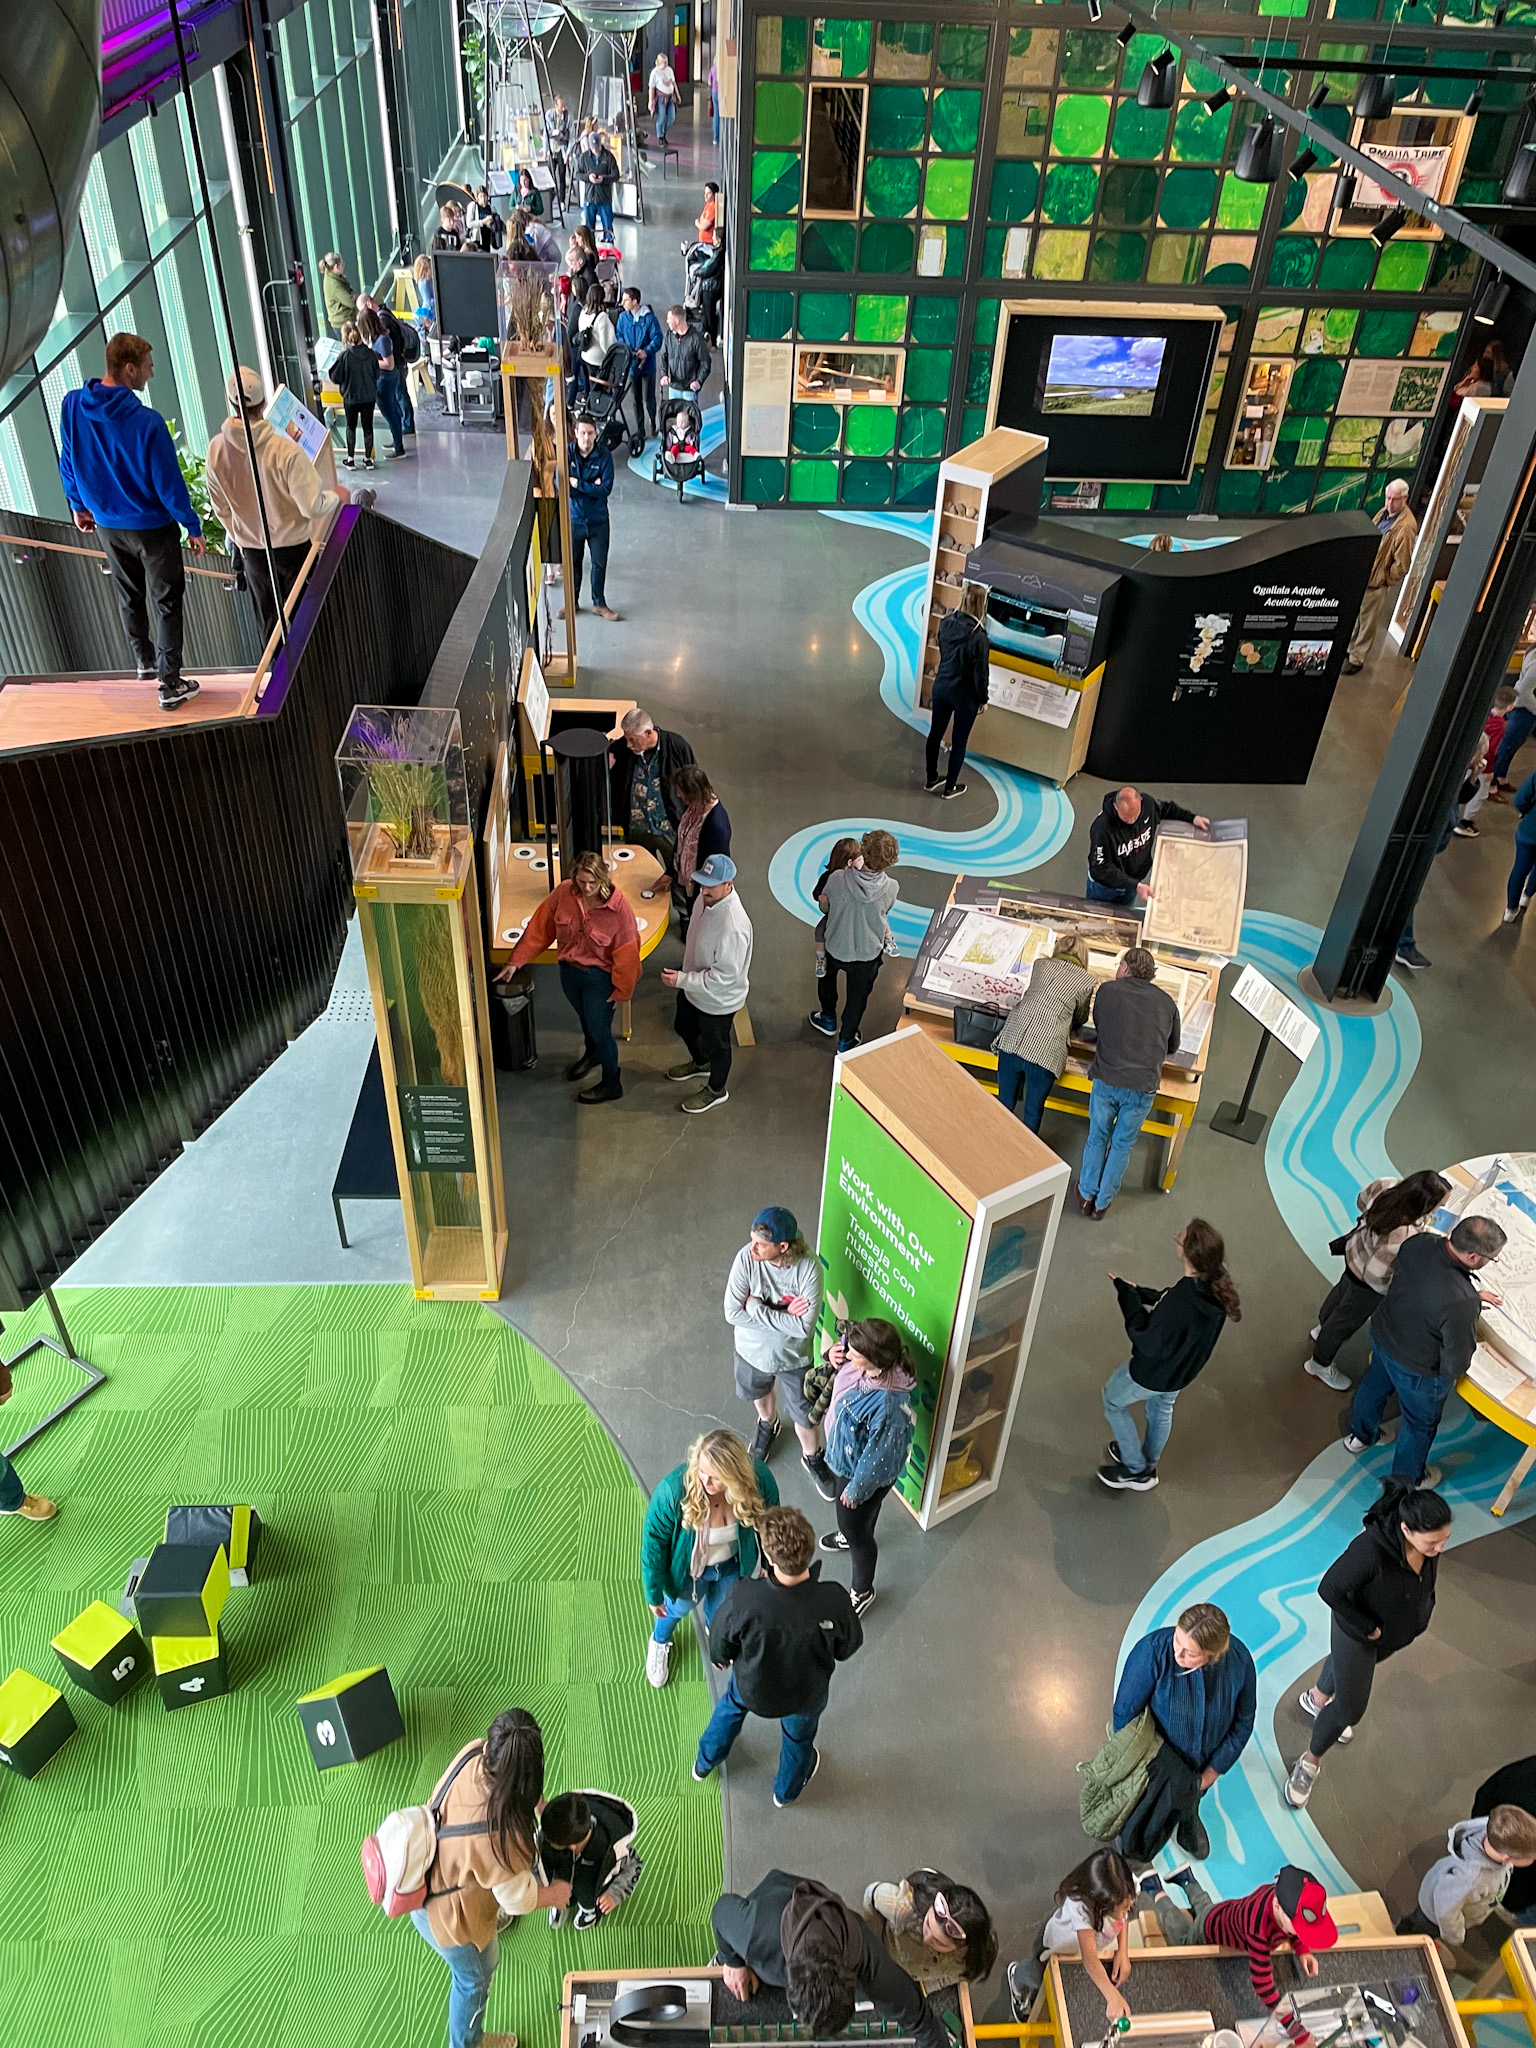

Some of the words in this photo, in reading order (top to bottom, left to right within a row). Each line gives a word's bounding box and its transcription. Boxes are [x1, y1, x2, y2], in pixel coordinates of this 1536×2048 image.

[1369, 147, 1410, 159] OMAHA
[1253, 585, 1291, 597] Ogallala
[1291, 585, 1326, 597] Aquifer
[1302, 597, 1340, 609] Ogallala
[839, 1172, 922, 1273] Environment
[841, 1155, 874, 1203] Work
[876, 1198, 905, 1237] with
[908, 1231, 936, 1267] Our
[846, 1231, 890, 1286] nuestro
[849, 1212, 891, 1269] Trabaja
[892, 1267, 916, 1298] con
[844, 1246, 936, 1355] medioambiente
[111, 1656, 136, 1682] 5
[179, 1677, 206, 1693] 4
